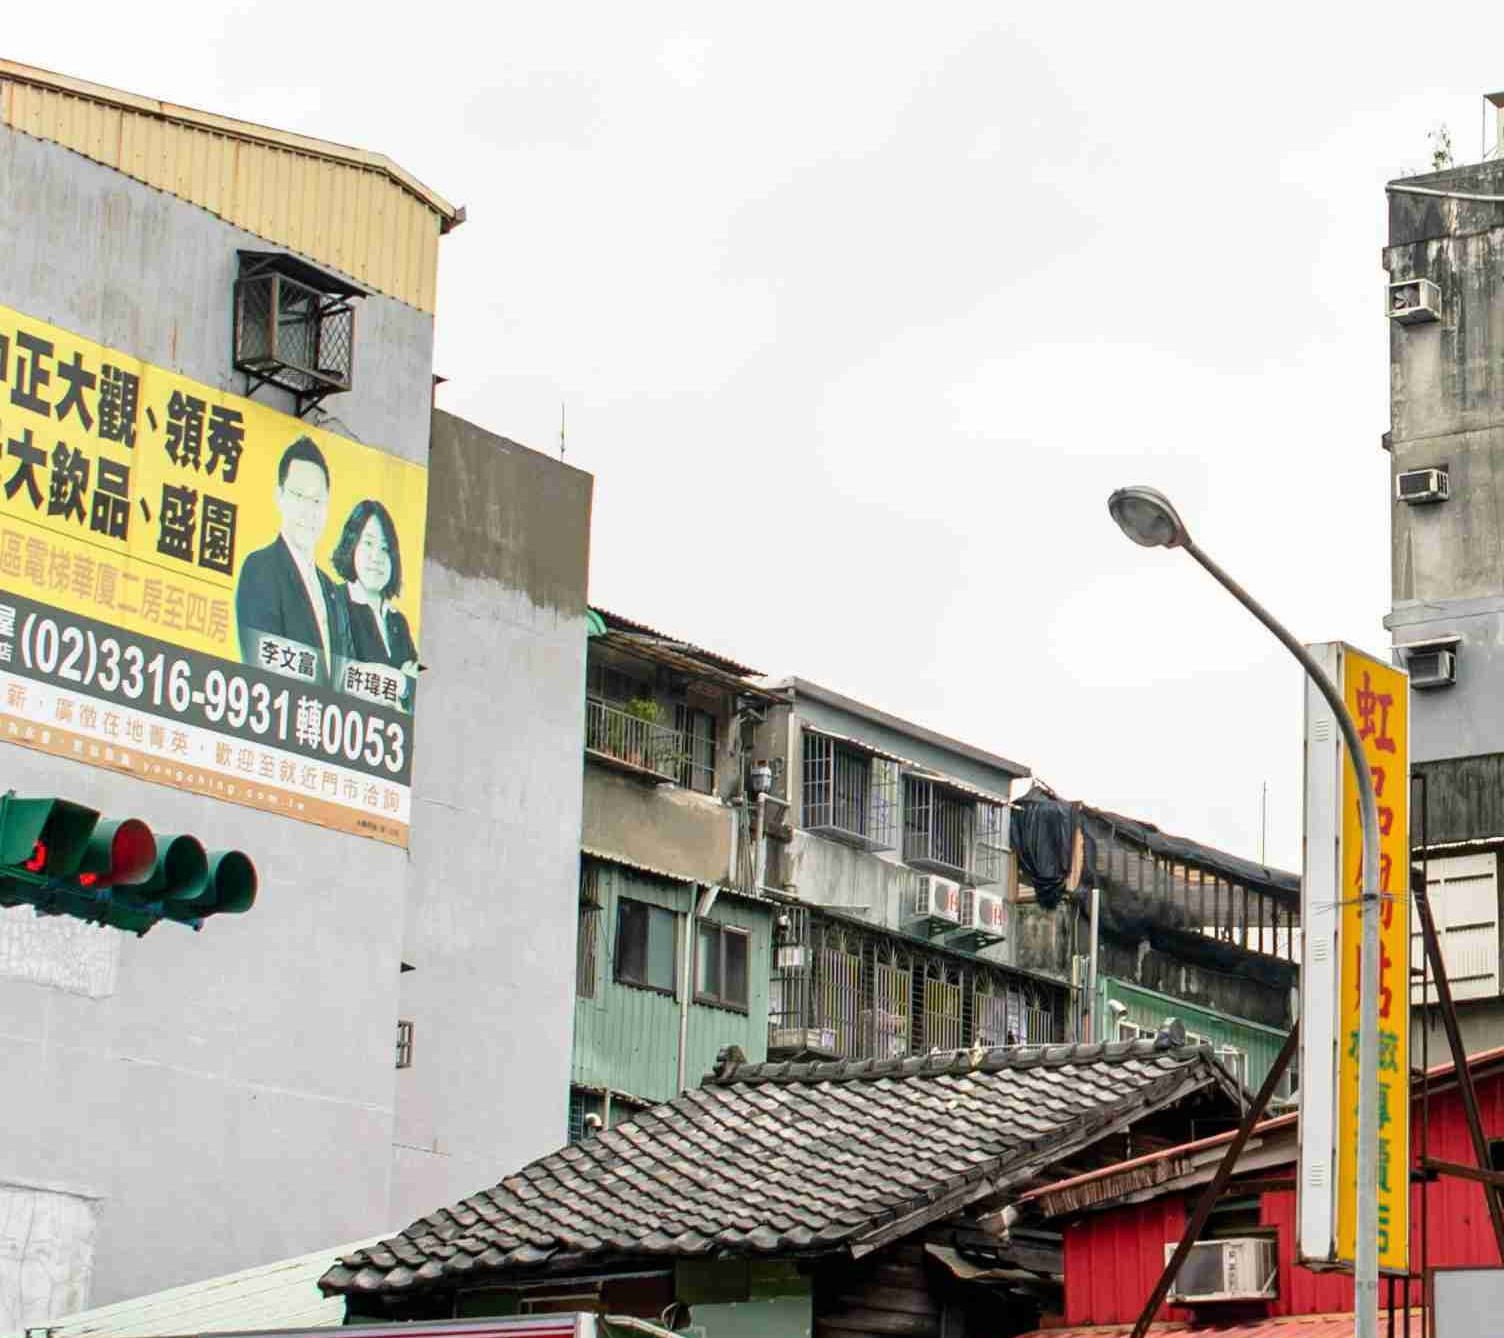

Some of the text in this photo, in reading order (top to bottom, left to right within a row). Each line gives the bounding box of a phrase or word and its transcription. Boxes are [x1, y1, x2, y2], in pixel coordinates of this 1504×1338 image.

[260, 639, 317, 677] 李文富
[347, 665, 399, 701] 許瑋君
